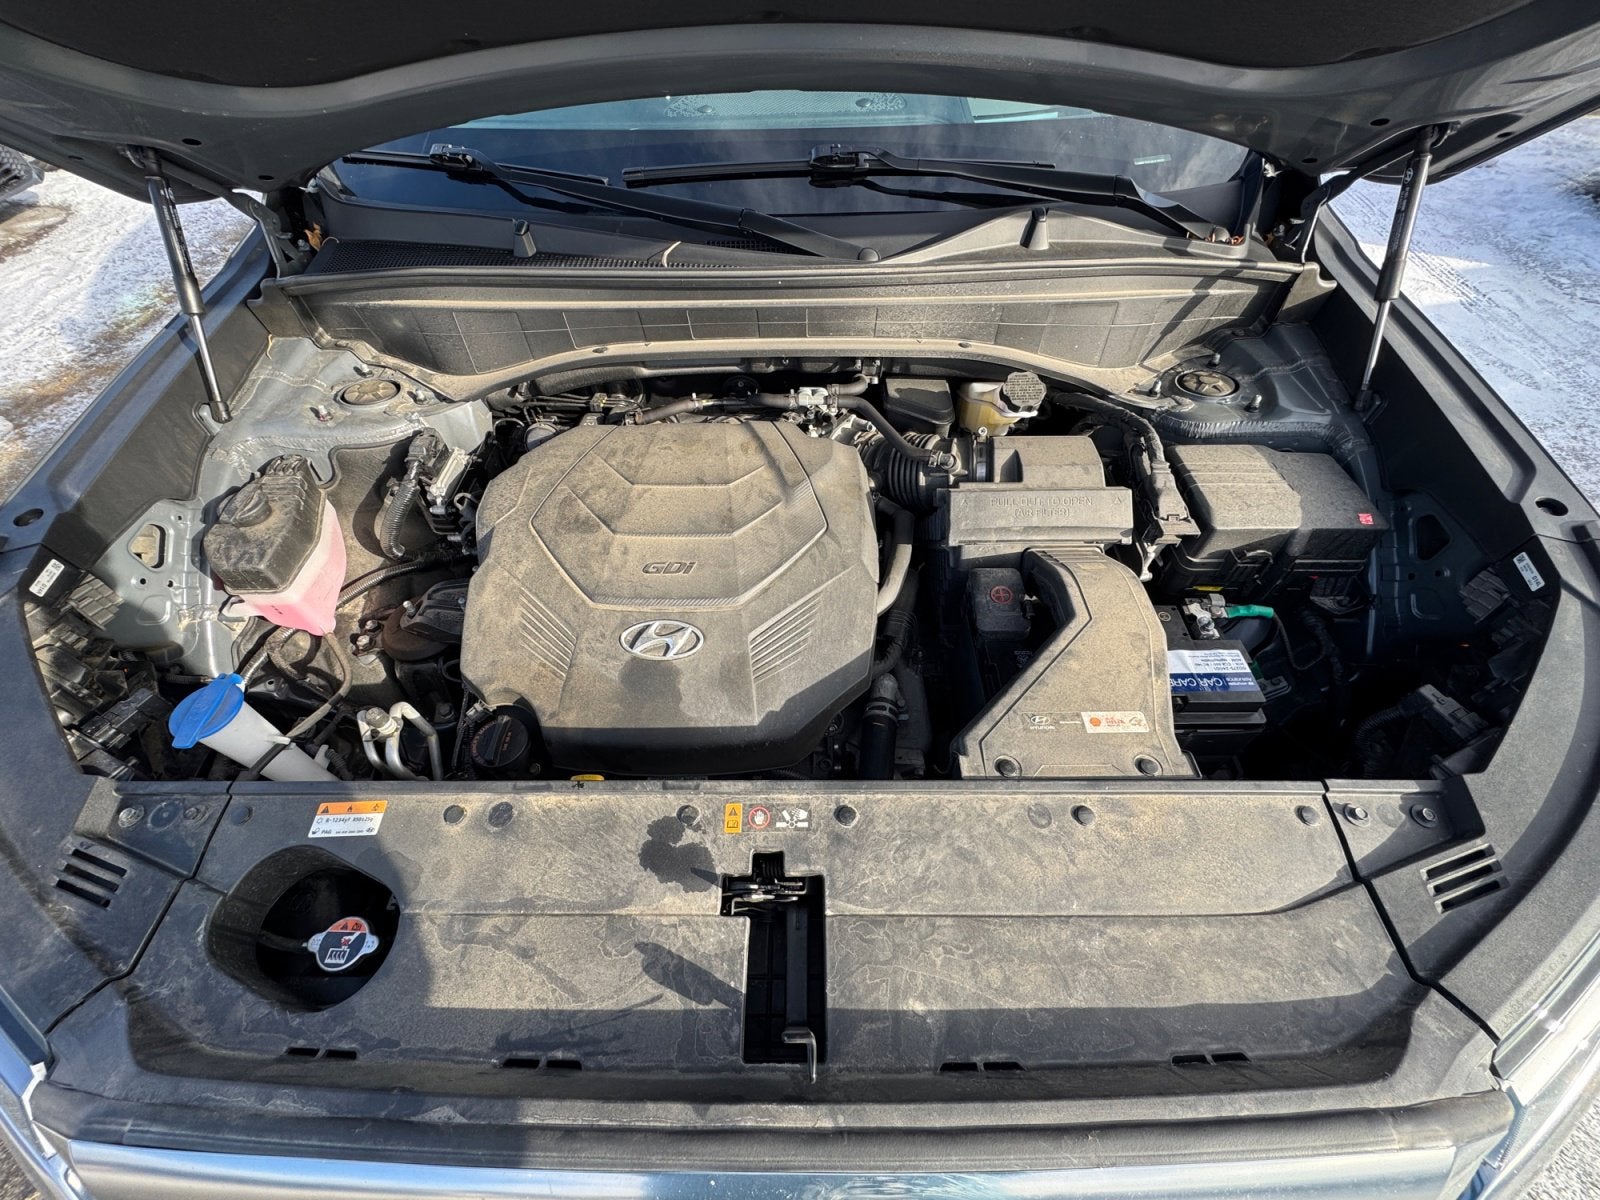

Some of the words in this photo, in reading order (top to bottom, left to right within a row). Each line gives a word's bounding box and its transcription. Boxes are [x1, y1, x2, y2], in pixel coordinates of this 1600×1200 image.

[991, 496, 1018, 506] PULL
[1021, 496, 1043, 506] OUT
[1047, 496, 1060, 506] TO
[1062, 496, 1093, 506] OPEN
[1200, 677, 1223, 687] CAR
